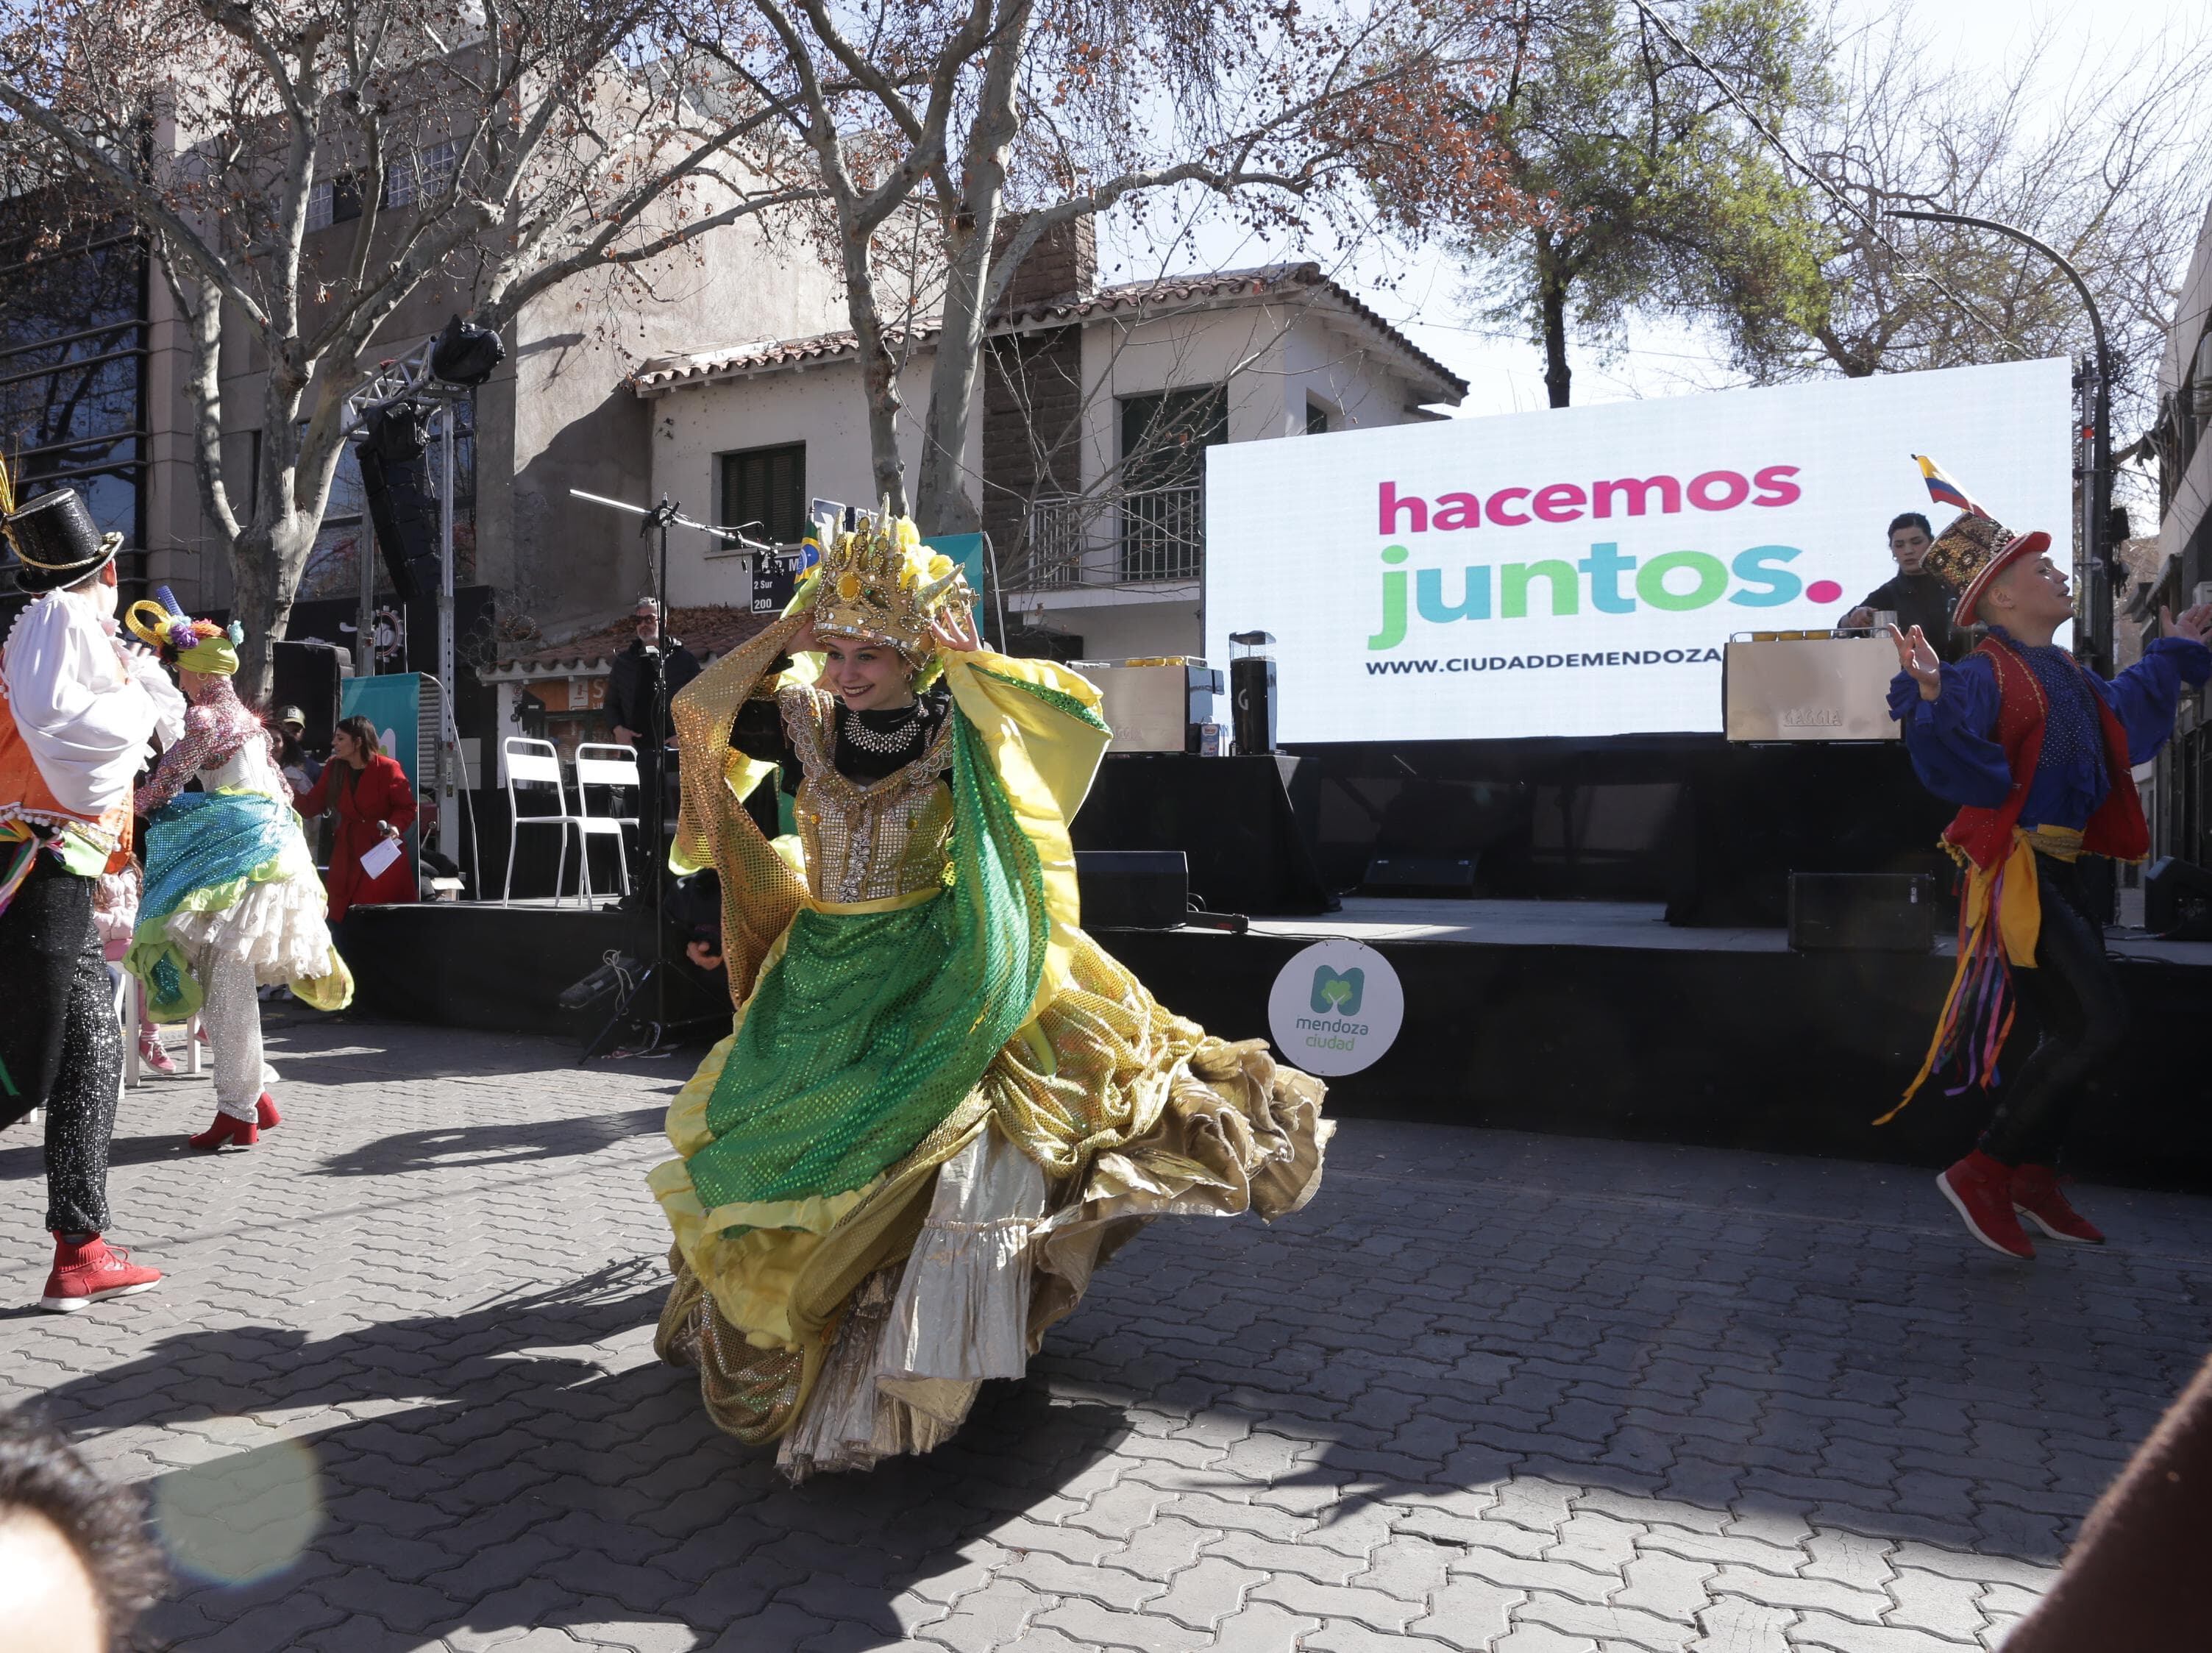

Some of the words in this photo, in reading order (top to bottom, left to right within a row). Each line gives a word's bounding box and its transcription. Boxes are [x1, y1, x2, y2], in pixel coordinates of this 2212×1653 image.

[1379, 466, 1801, 536] hacemos
[754, 580, 758, 589] 2
[760, 580, 772, 589] Sur
[754, 598, 772, 610] 200
[1368, 542, 1843, 651] juntos.
[1366, 648, 1722, 675] WWW.CIUDADDEMENDOZA
[1784, 708, 1842, 726] GAGGIA
[1296, 1017, 1369, 1036] mendoza
[1305, 1034, 1355, 1051] ciudad
